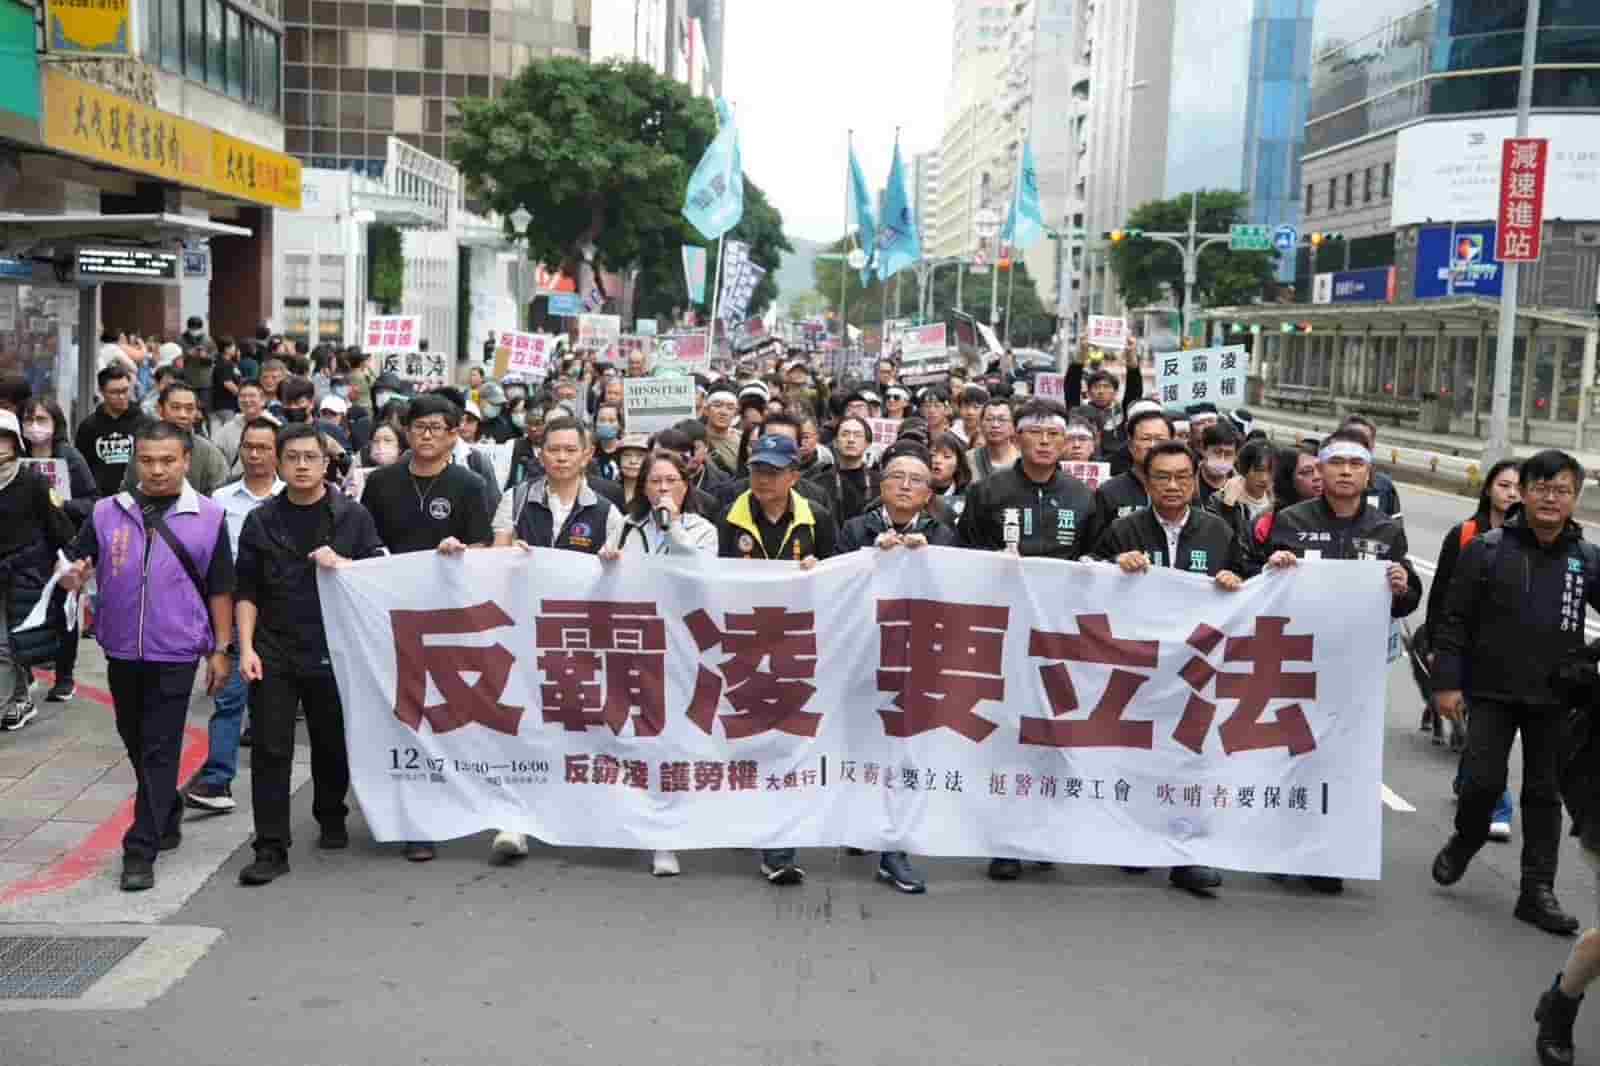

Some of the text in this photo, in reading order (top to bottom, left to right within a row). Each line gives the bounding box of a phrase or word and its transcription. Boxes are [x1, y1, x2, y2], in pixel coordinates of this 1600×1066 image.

[1504, 142, 1539, 256] 減速進站
[1163, 352, 1237, 376] 反霸凌
[1162, 377, 1237, 401] 護勞權
[389, 597, 1318, 755] 反霸凌 要立法
[564, 753, 649, 789] 反霸凌
[660, 760, 758, 792] 護勞權
[990, 771, 1131, 802] 挺警消要工會
[1157, 782, 1309, 811] 吹哨者要保護
